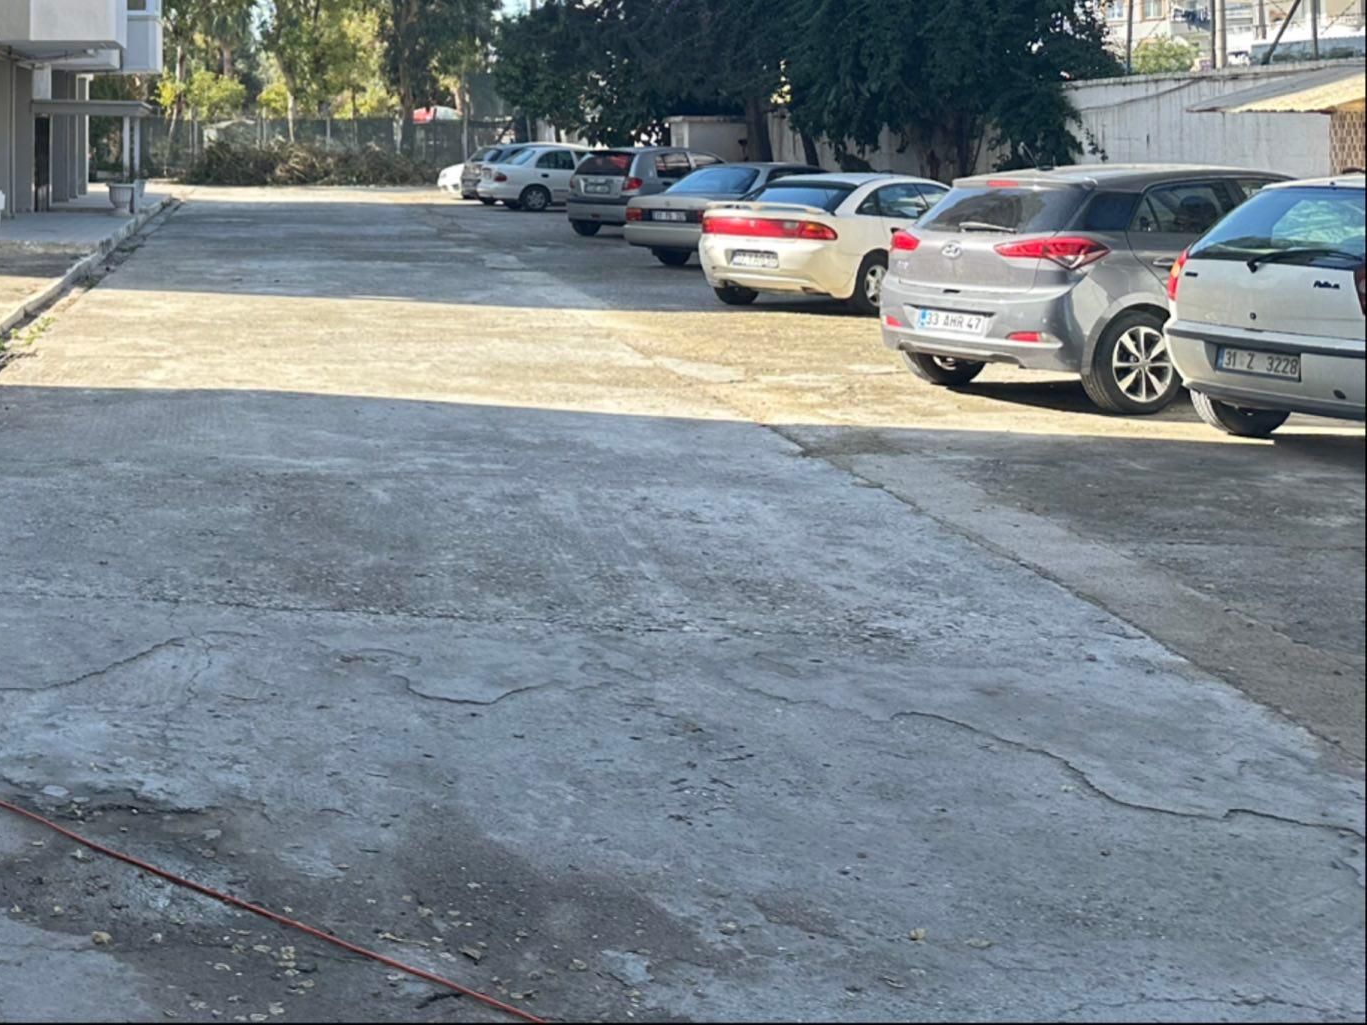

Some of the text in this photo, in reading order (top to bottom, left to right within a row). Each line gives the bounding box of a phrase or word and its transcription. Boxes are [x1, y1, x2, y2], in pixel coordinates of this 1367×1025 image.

[927, 312, 939, 326] 33
[966, 317, 982, 331] 47
[1225, 351, 1298, 375] 31 Z 3228
